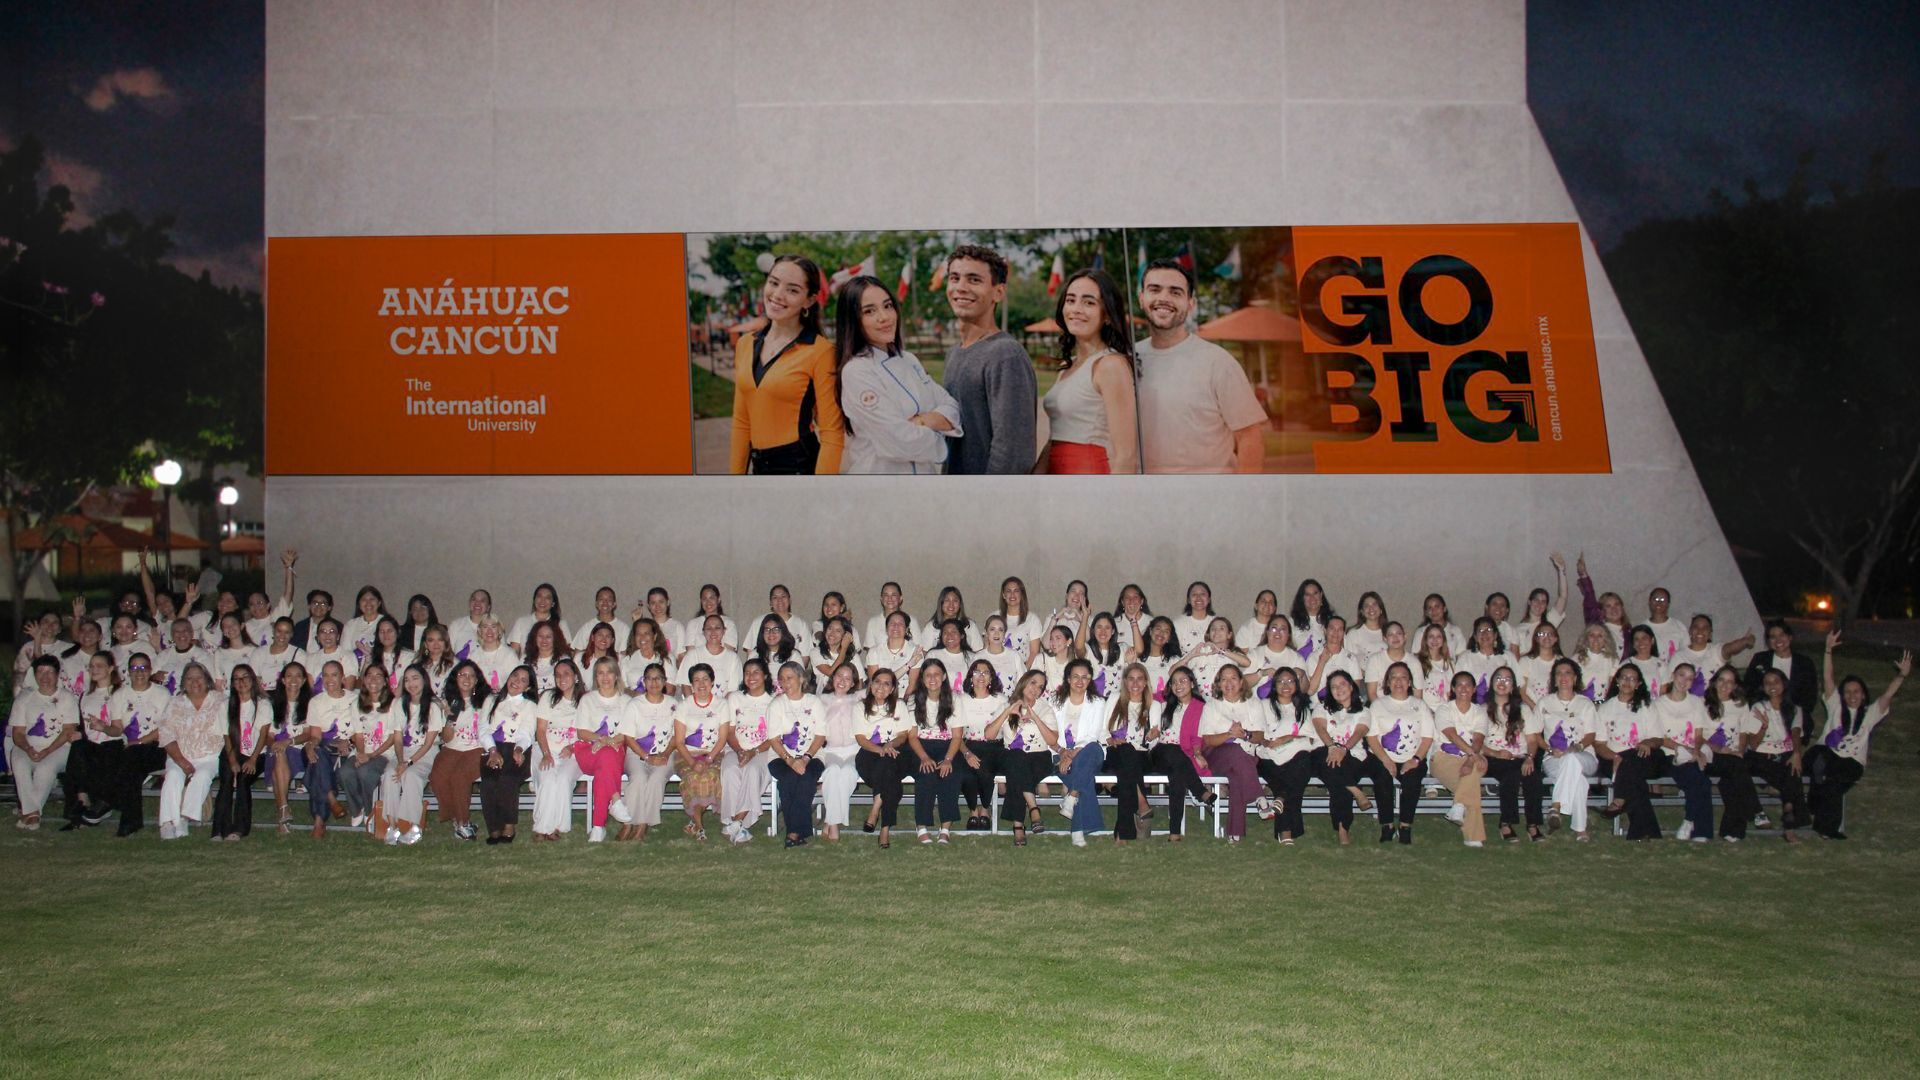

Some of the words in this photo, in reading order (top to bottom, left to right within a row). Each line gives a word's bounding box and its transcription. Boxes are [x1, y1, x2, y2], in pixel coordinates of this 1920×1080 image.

[378, 278, 569, 316] ANÁHUAC
[1299, 254, 1494, 347] GO
[390, 317, 559, 354] CANCÚN
[405, 378, 431, 391] The
[1305, 350, 1540, 443] BIG
[1537, 315, 1563, 442] cancun.anahuac.mx
[406, 395, 546, 415] International
[467, 418, 537, 433] University
